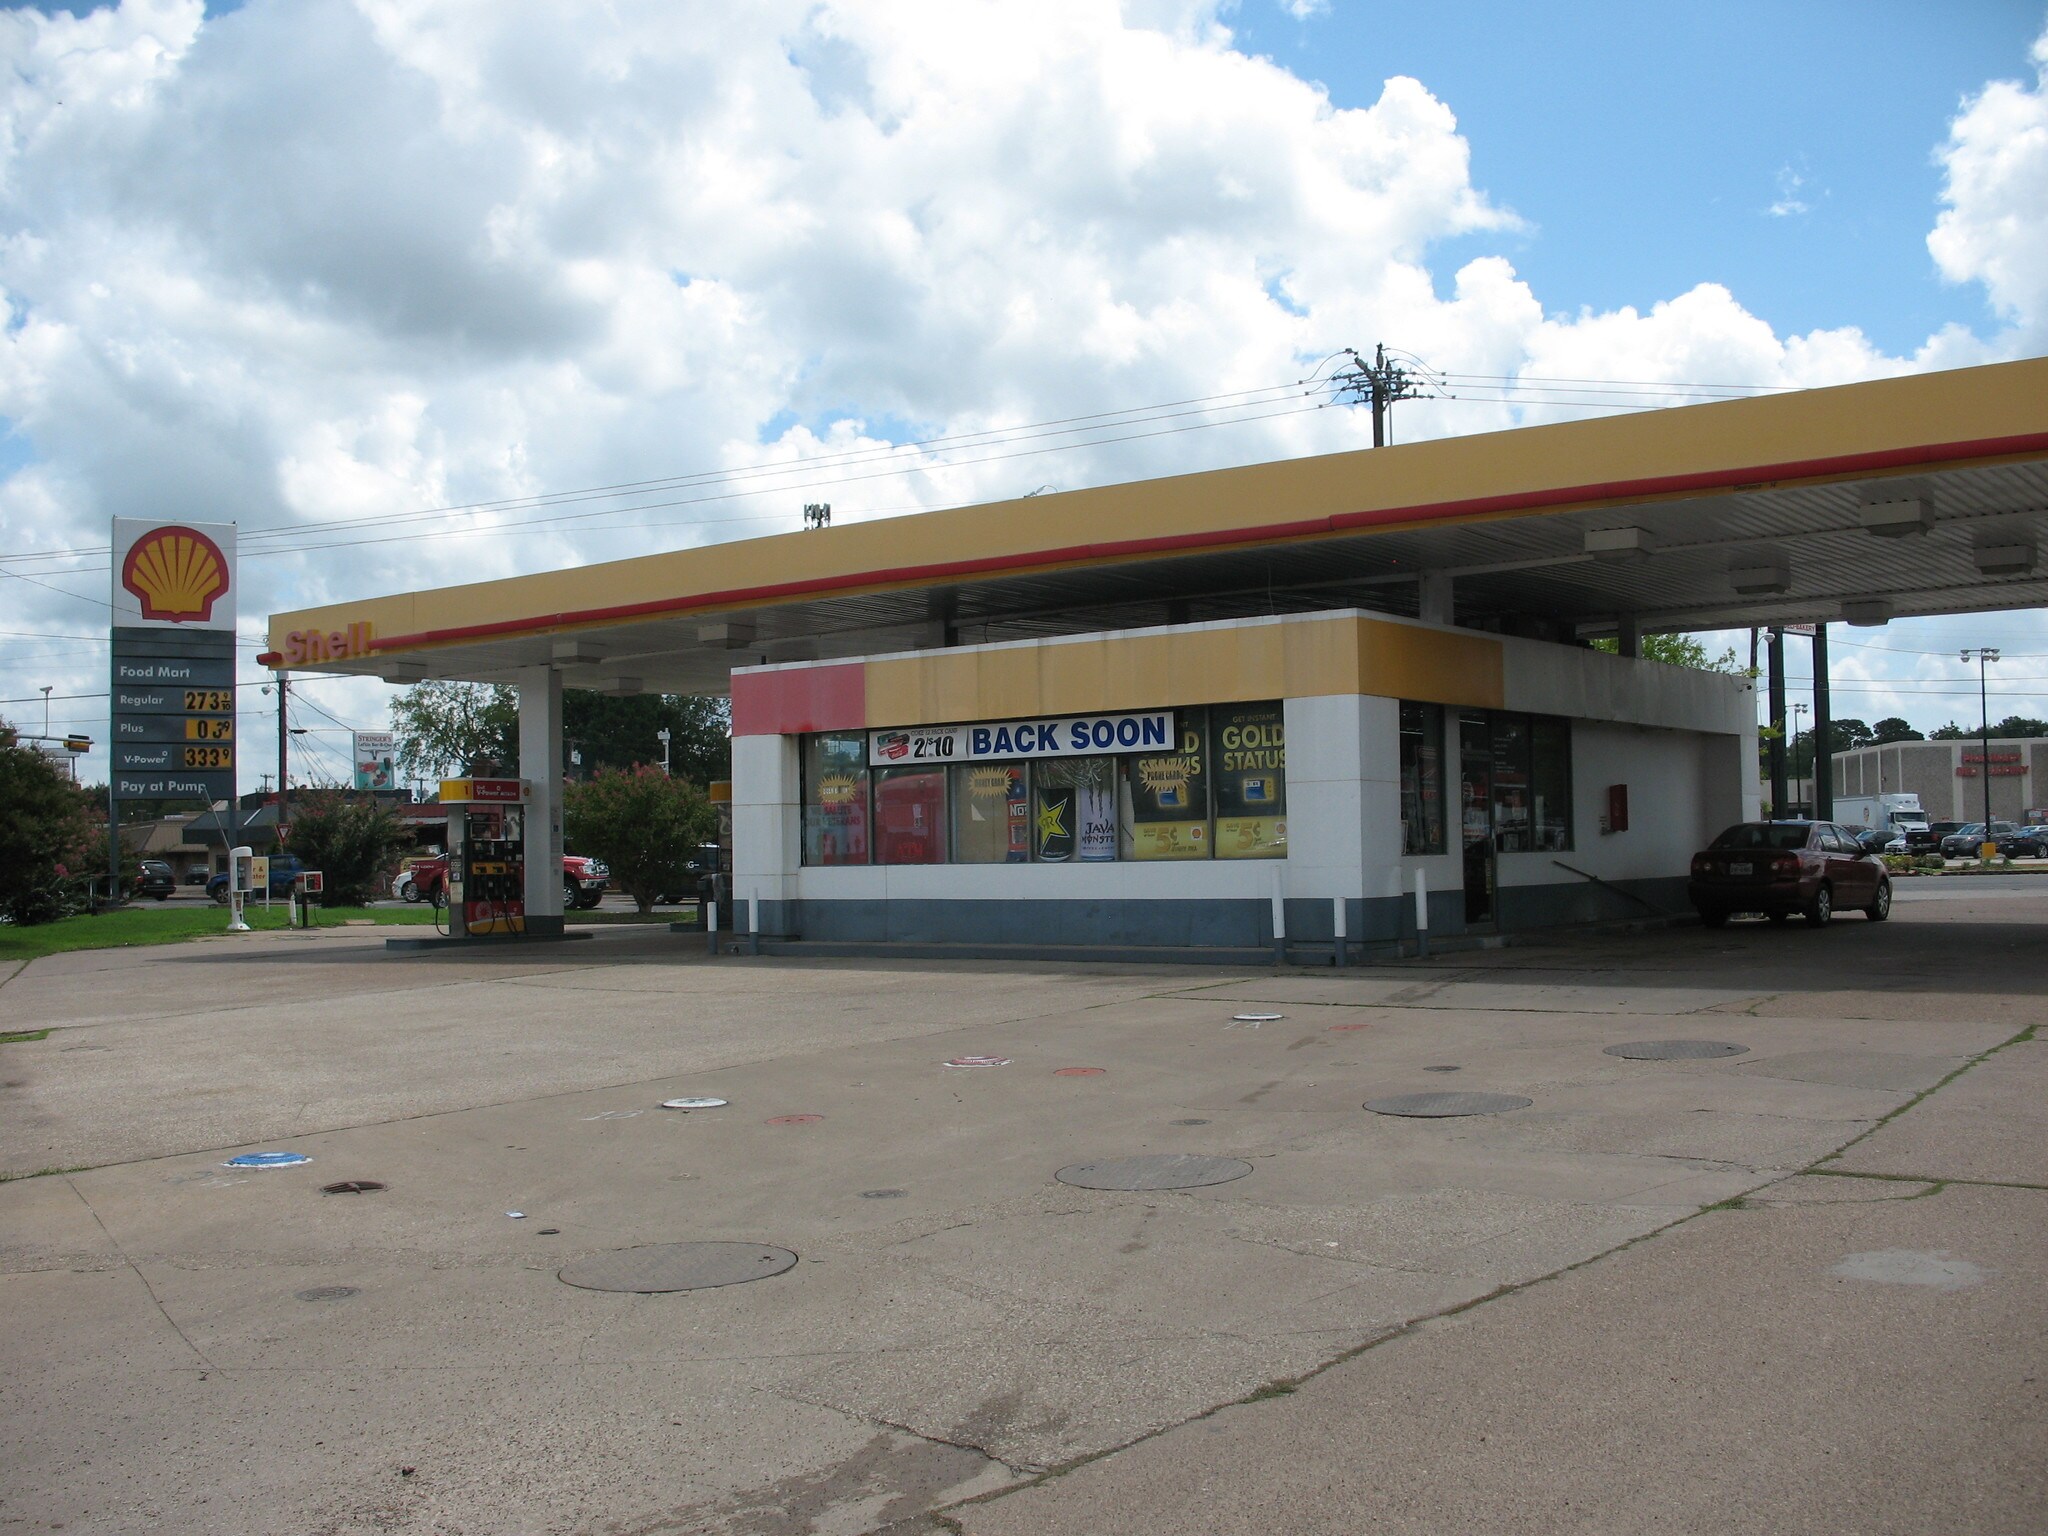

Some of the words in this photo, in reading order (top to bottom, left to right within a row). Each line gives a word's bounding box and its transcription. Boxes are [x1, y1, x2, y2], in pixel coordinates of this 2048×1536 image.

[284, 621, 372, 664] Shell
[120, 666, 153, 677] Food
[158, 667, 190, 679] Mart
[120, 695, 164, 707] Regular
[120, 724, 144, 734] Plus
[973, 723, 1060, 754] BACK
[1070, 716, 1166, 750] SOON
[1222, 723, 1285, 751] GOLD
[124, 755, 166, 764] V-Power
[1224, 747, 1286, 772] STATUS
[1963, 752, 2022, 763] PHAMACY
[120, 780, 146, 795] Pay
[150, 781, 164, 792] at
[168, 780, 207, 794] Pump
[1085, 818, 1115, 835] JAVA
[1082, 834, 1115, 845] MONSTE
